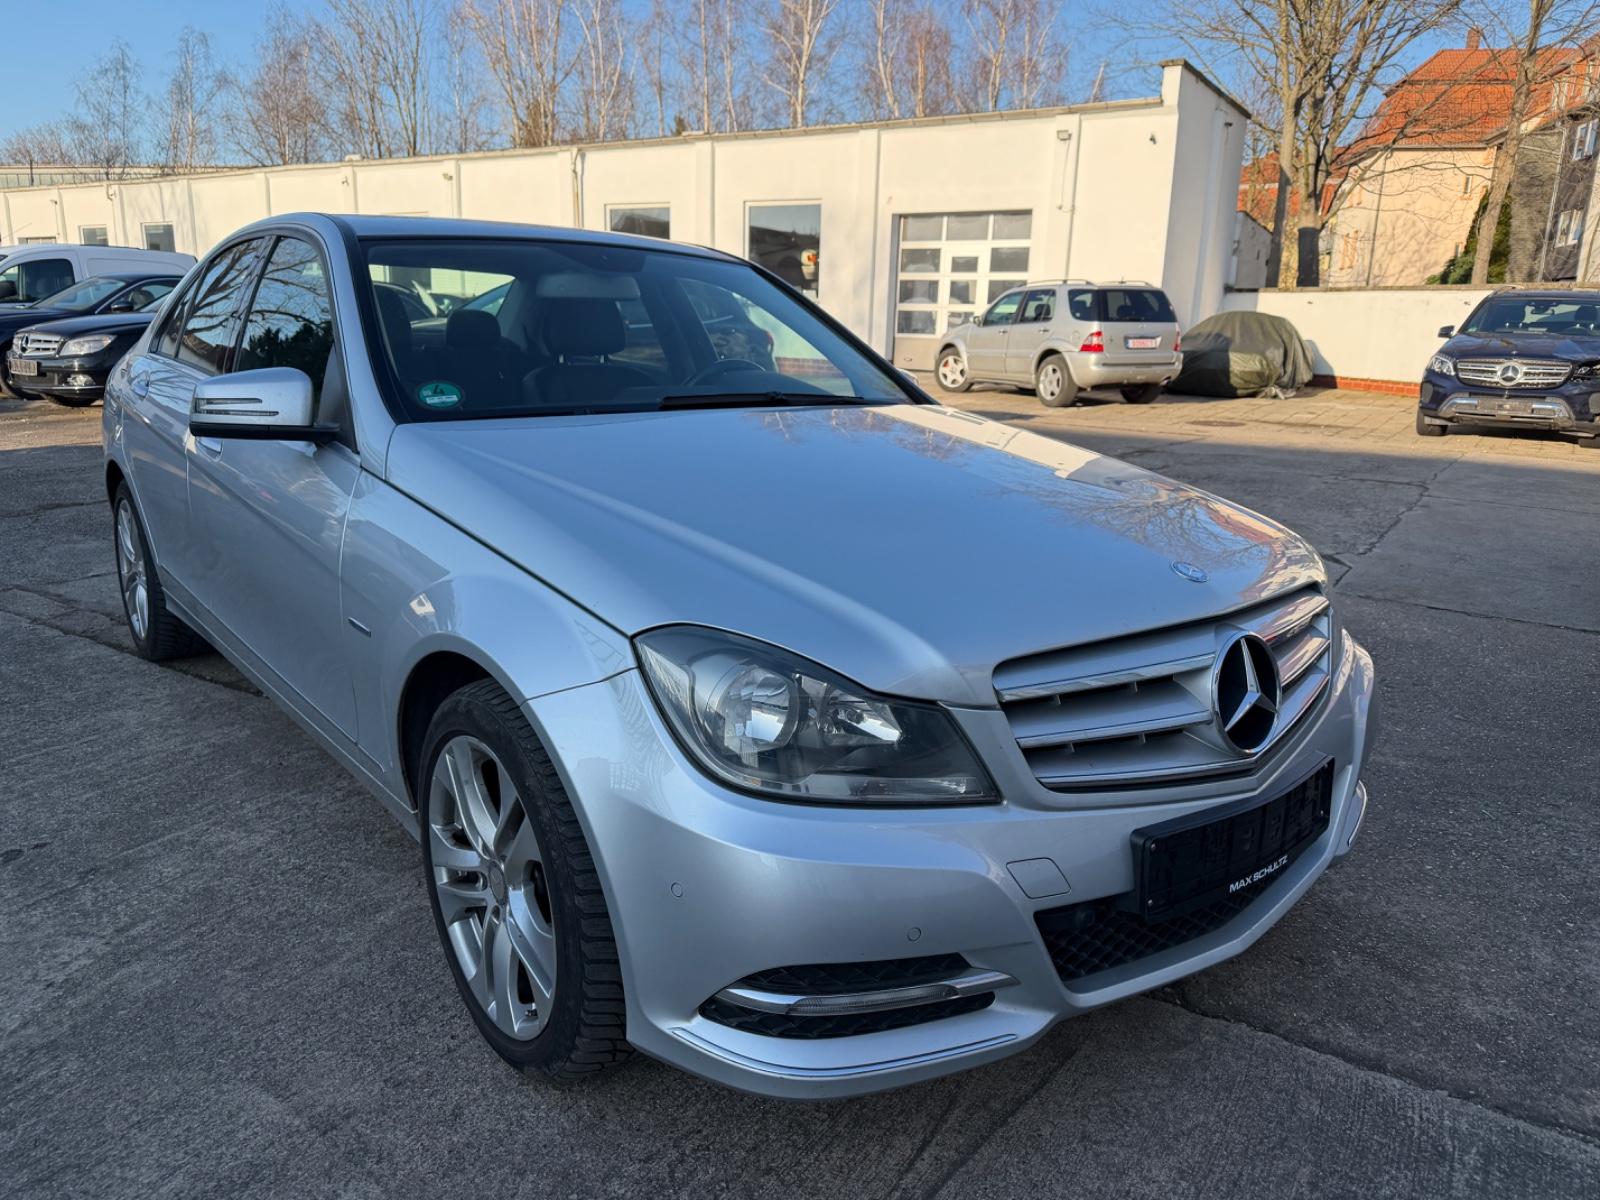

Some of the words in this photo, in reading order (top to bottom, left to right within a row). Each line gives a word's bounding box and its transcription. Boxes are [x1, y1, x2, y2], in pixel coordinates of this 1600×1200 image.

[433, 384, 445, 394] 4
[1229, 875, 1252, 893] MAX
[1253, 855, 1289, 881] SCHULTZ
